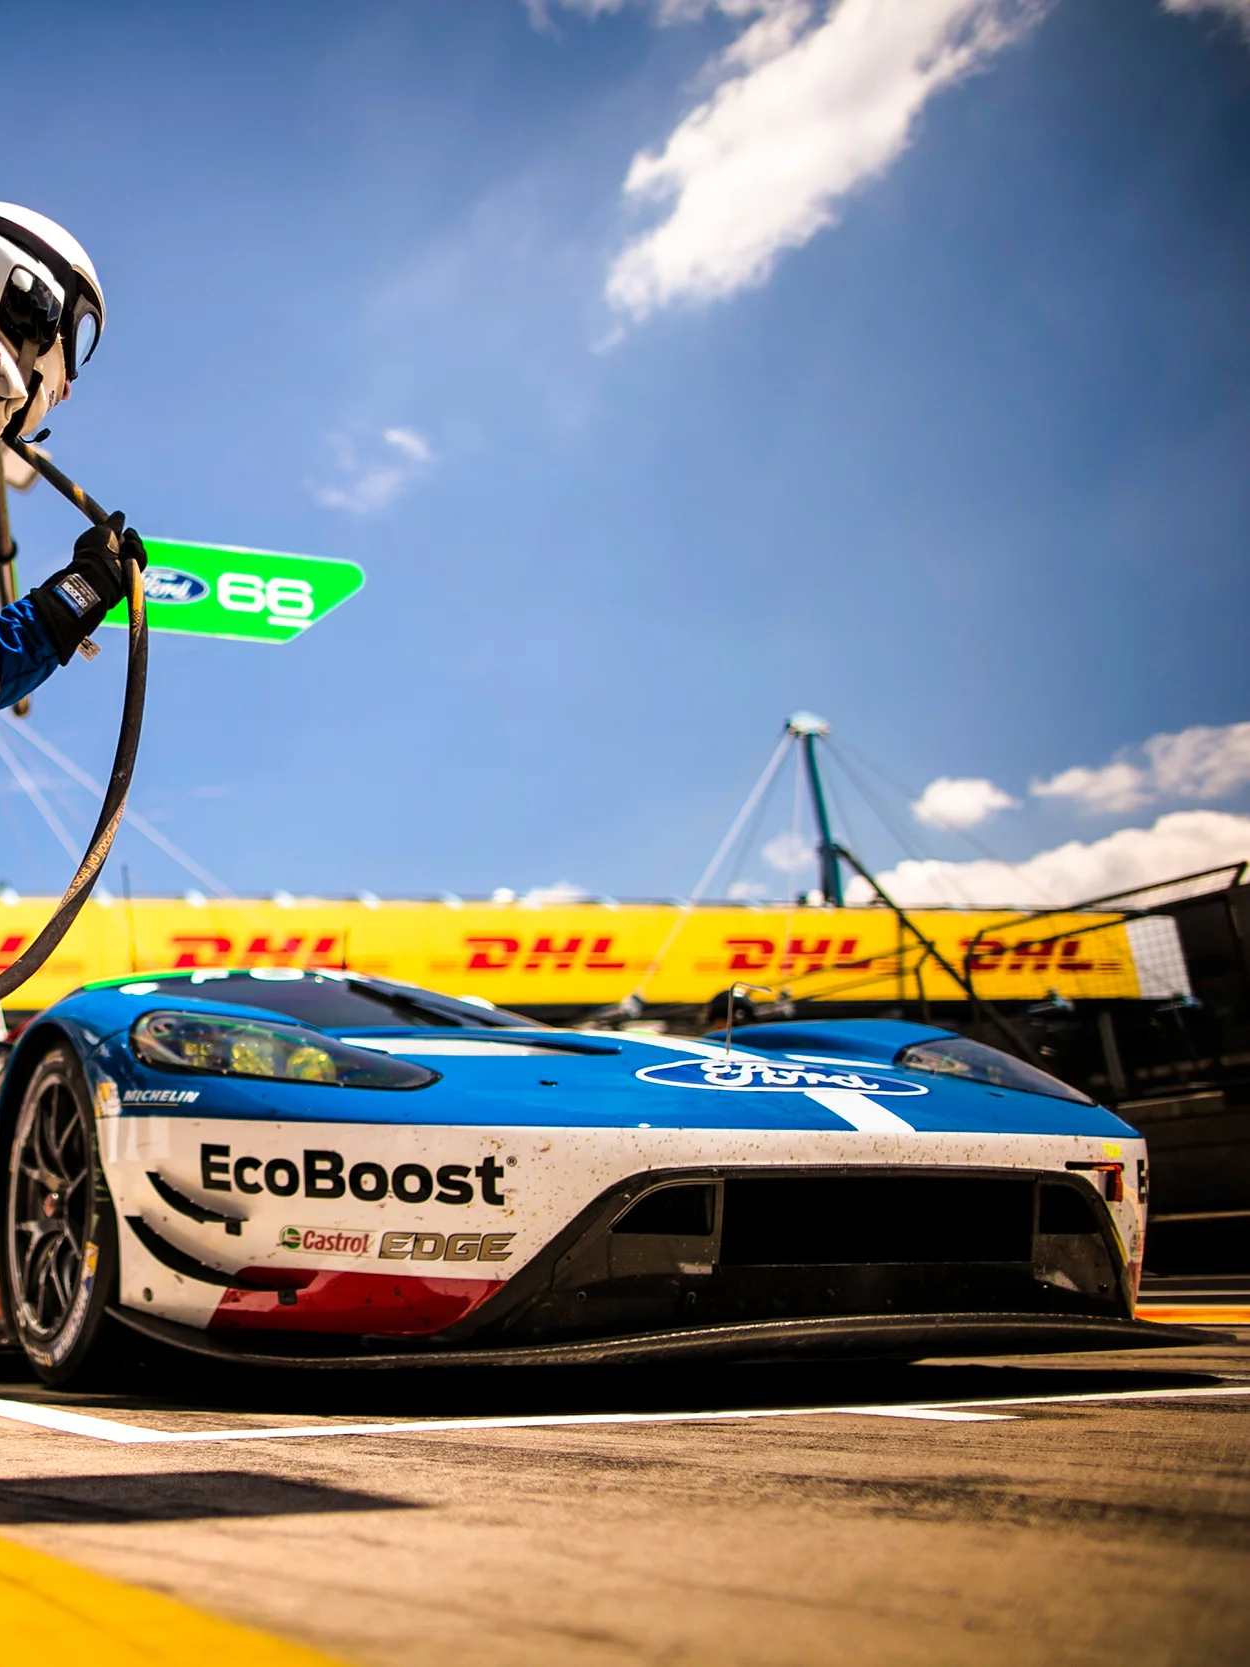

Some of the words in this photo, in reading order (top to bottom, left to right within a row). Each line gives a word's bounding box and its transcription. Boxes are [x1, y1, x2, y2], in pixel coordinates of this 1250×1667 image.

[217, 572, 314, 619] 66
[171, 936, 347, 970] DHL
[464, 937, 626, 970] DHL
[723, 938, 872, 972] DHL
[957, 938, 1094, 972] DHL
[699, 1061, 880, 1091] Ford
[123, 1089, 201, 1104] MICHELIN
[302, 1229, 371, 1254] Castrol
[378, 1231, 518, 1262] EDGE
